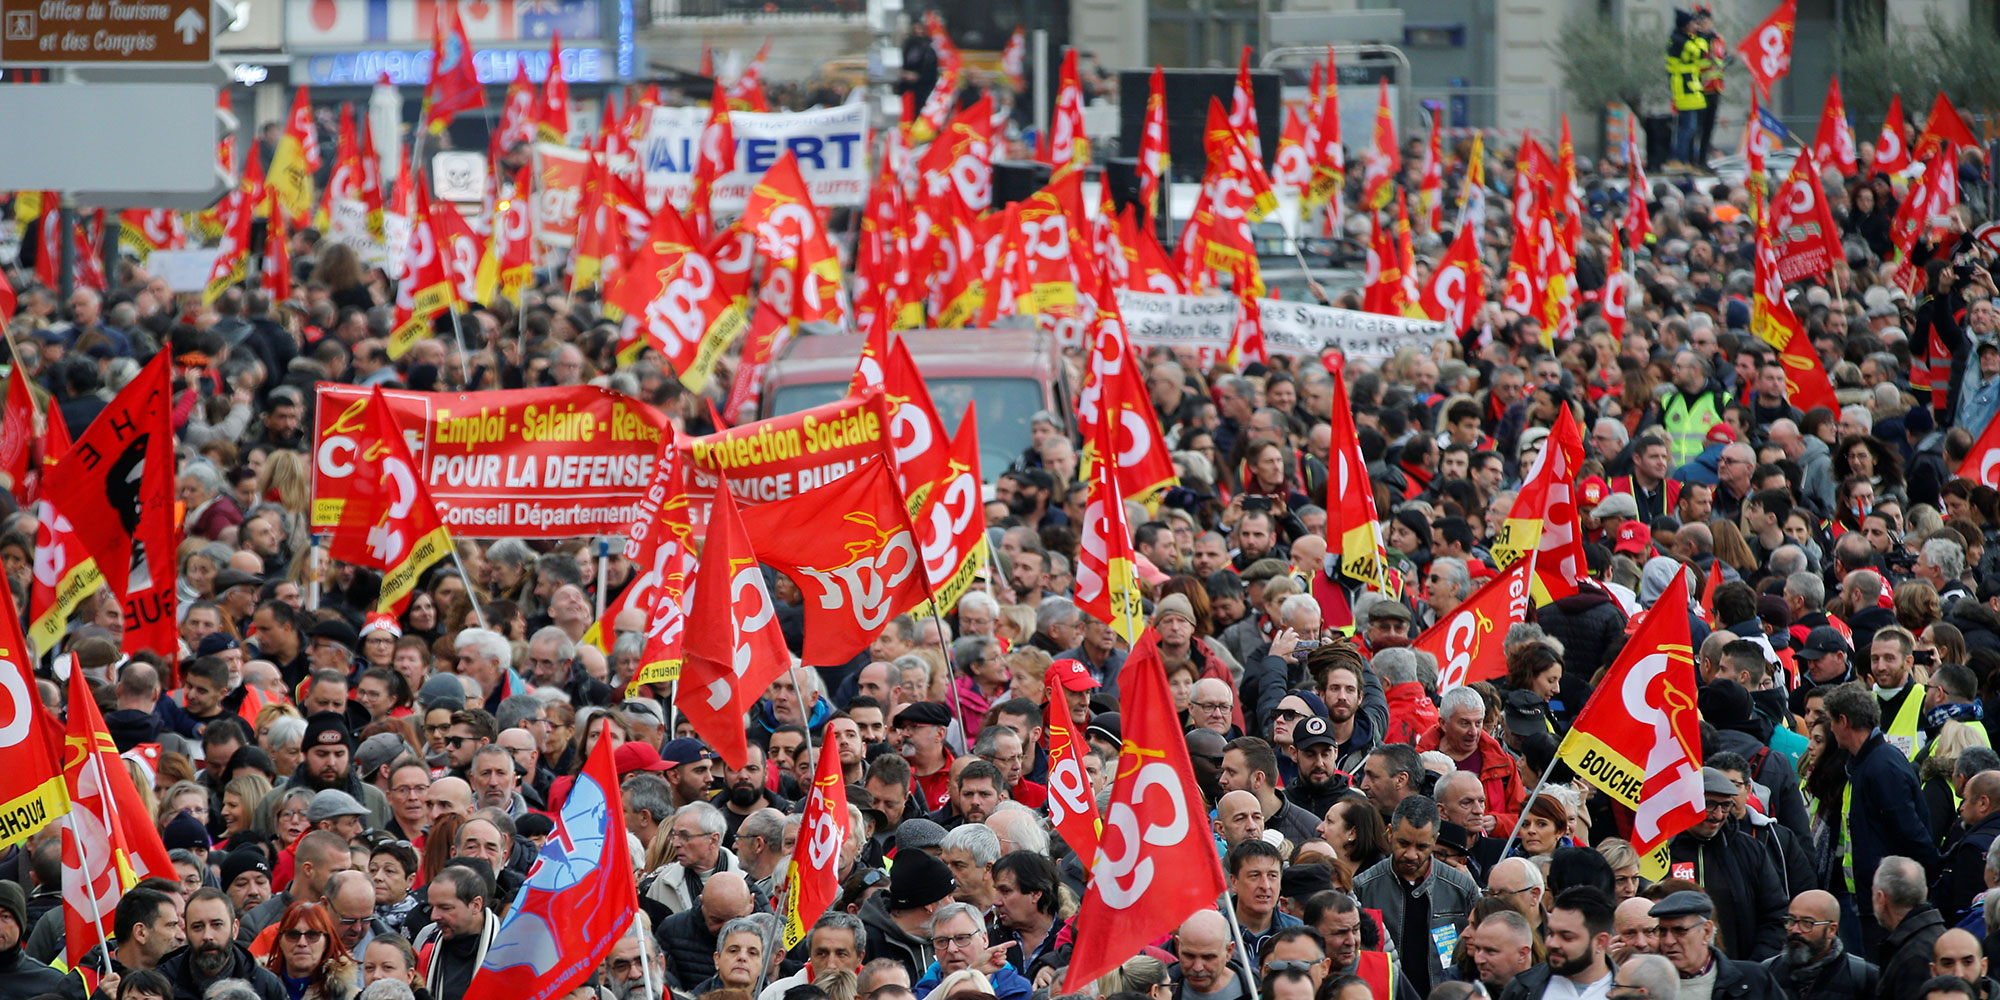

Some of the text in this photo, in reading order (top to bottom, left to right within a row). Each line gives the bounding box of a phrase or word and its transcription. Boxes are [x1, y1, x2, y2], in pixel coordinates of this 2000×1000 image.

[40, 1, 171, 20] Office du Tourisme
[39, 30, 157, 56] et des Congrès
[1141, 318, 1195, 337] Salon
[435, 406, 506, 452] Emploi
[521, 403, 596, 443] Salaire
[690, 422, 803, 471] Protection
[803, 405, 882, 455] Sociale
[430, 455, 501, 488] POUR
[505, 455, 538, 488] LA
[543, 453, 654, 488] DEFENSE
[436, 502, 509, 526] Conseil
[1673, 867, 1695, 880] cgt
